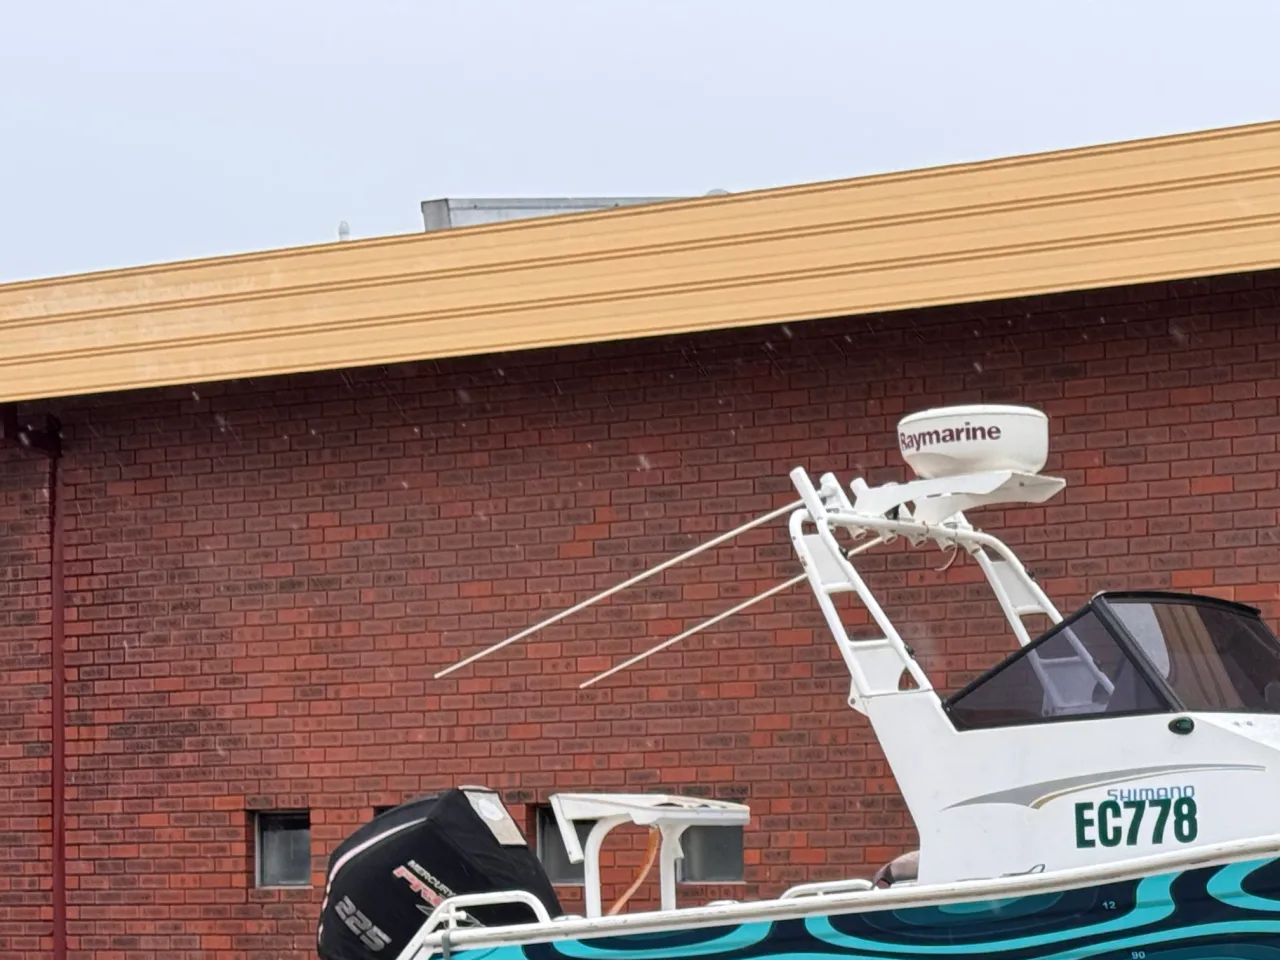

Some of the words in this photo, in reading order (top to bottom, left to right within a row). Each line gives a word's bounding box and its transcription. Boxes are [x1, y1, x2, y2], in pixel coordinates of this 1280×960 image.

[900, 421, 1002, 452] Raymarine
[1107, 785, 1196, 802] SHIMANO
[1074, 796, 1199, 849] EC778
[407, 859, 458, 897] MERCURY
[1102, 900, 1118, 911] 12
[334, 894, 393, 952] 225
[1131, 951, 1147, 960] 90
